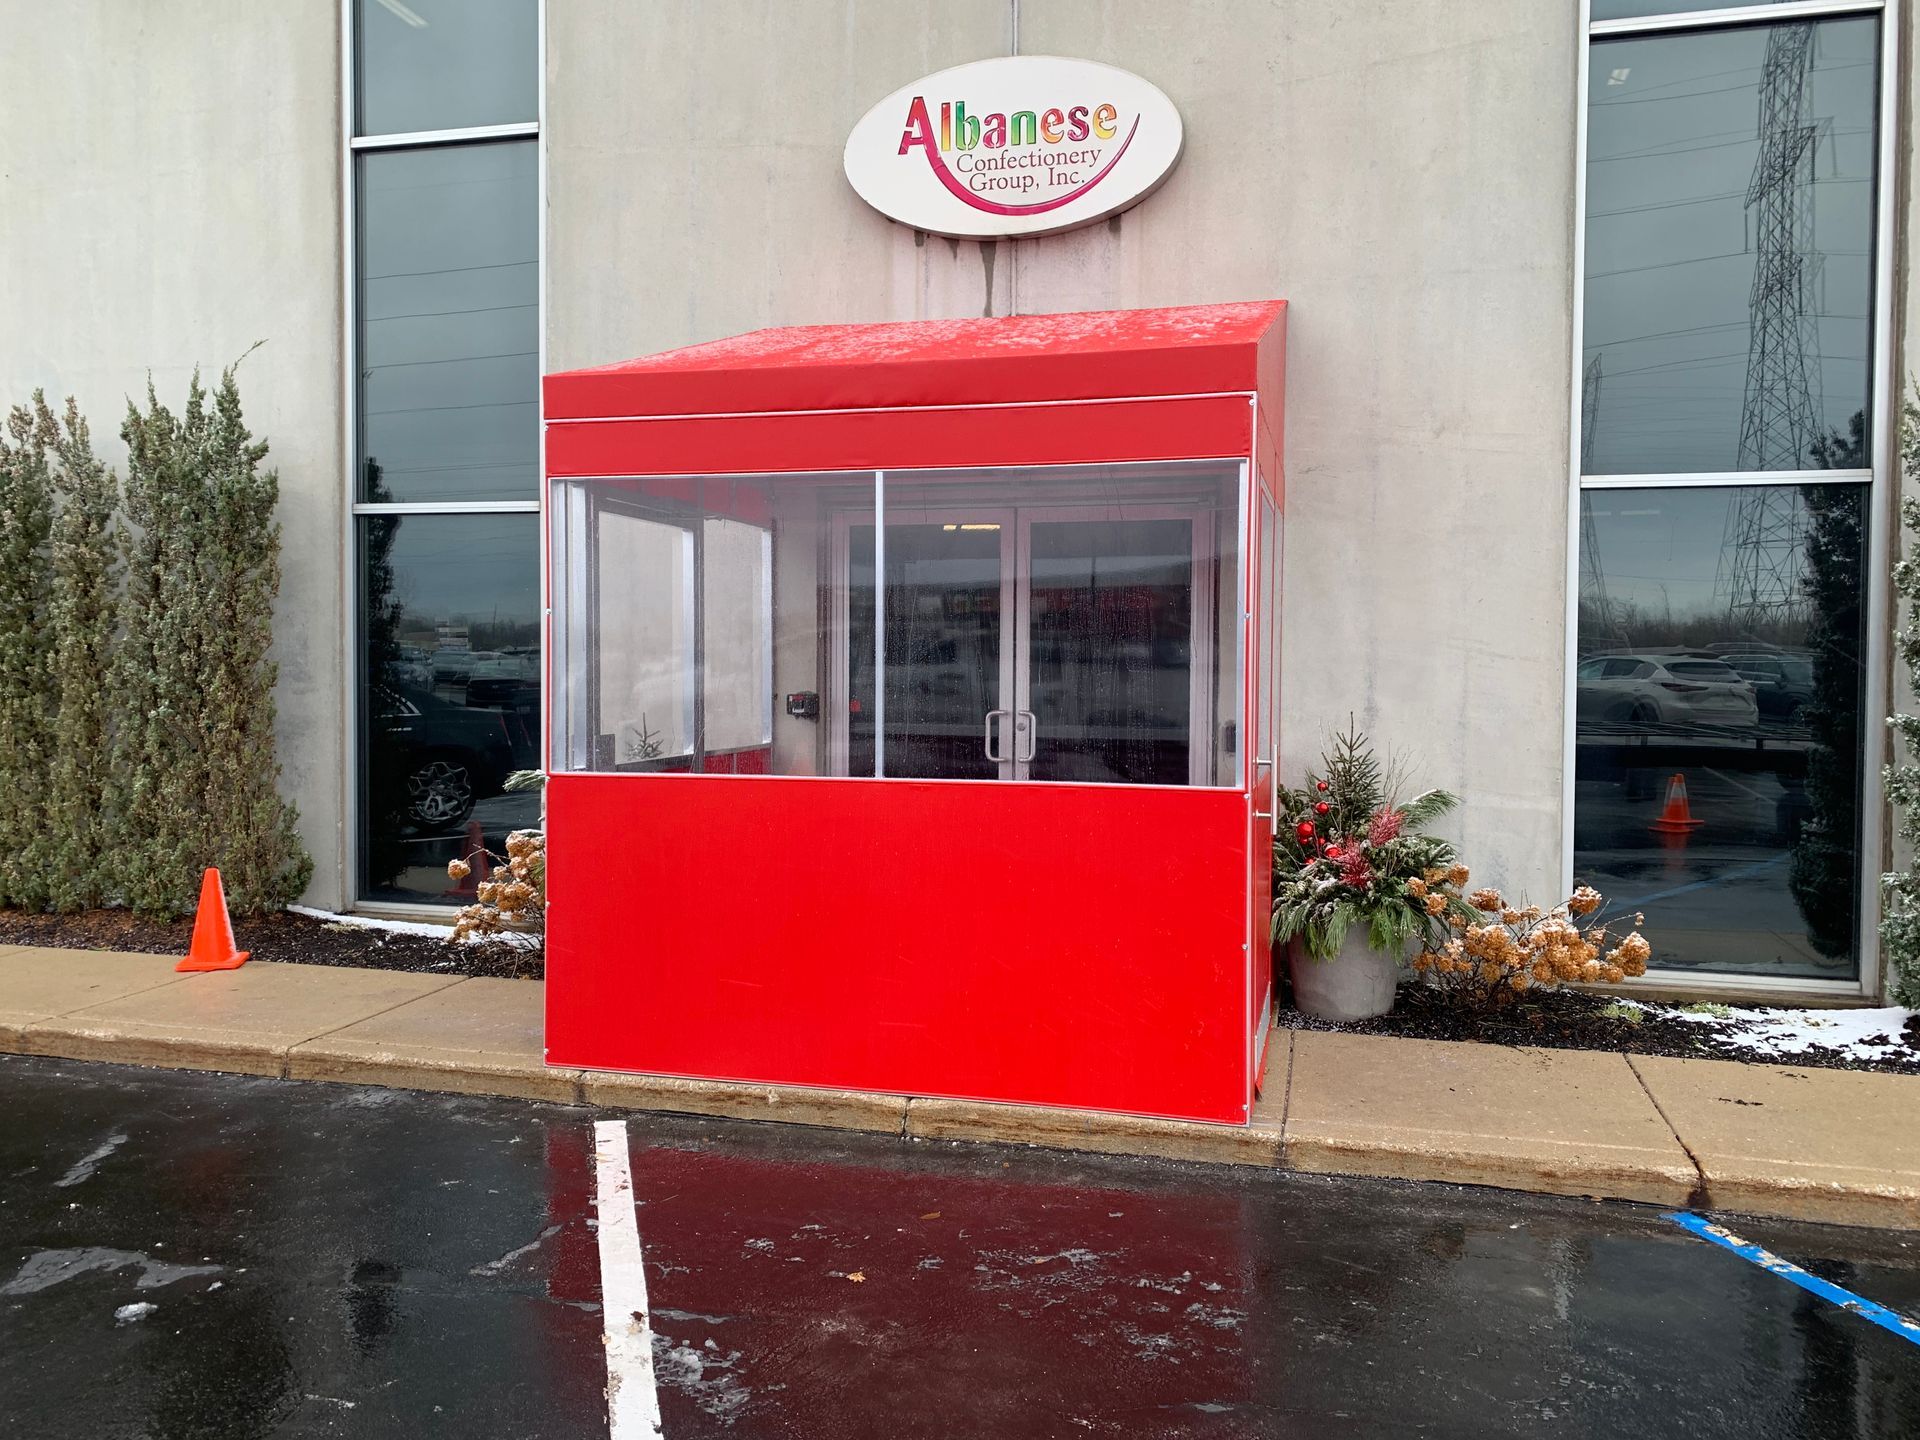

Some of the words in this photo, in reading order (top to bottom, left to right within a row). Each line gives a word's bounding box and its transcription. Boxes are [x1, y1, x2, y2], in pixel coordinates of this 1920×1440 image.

[898, 96, 1118, 156] Albanese
[956, 149, 1102, 174] Confectionery
[969, 172, 1040, 193] Group,
[1048, 168, 1085, 187] Inc.
